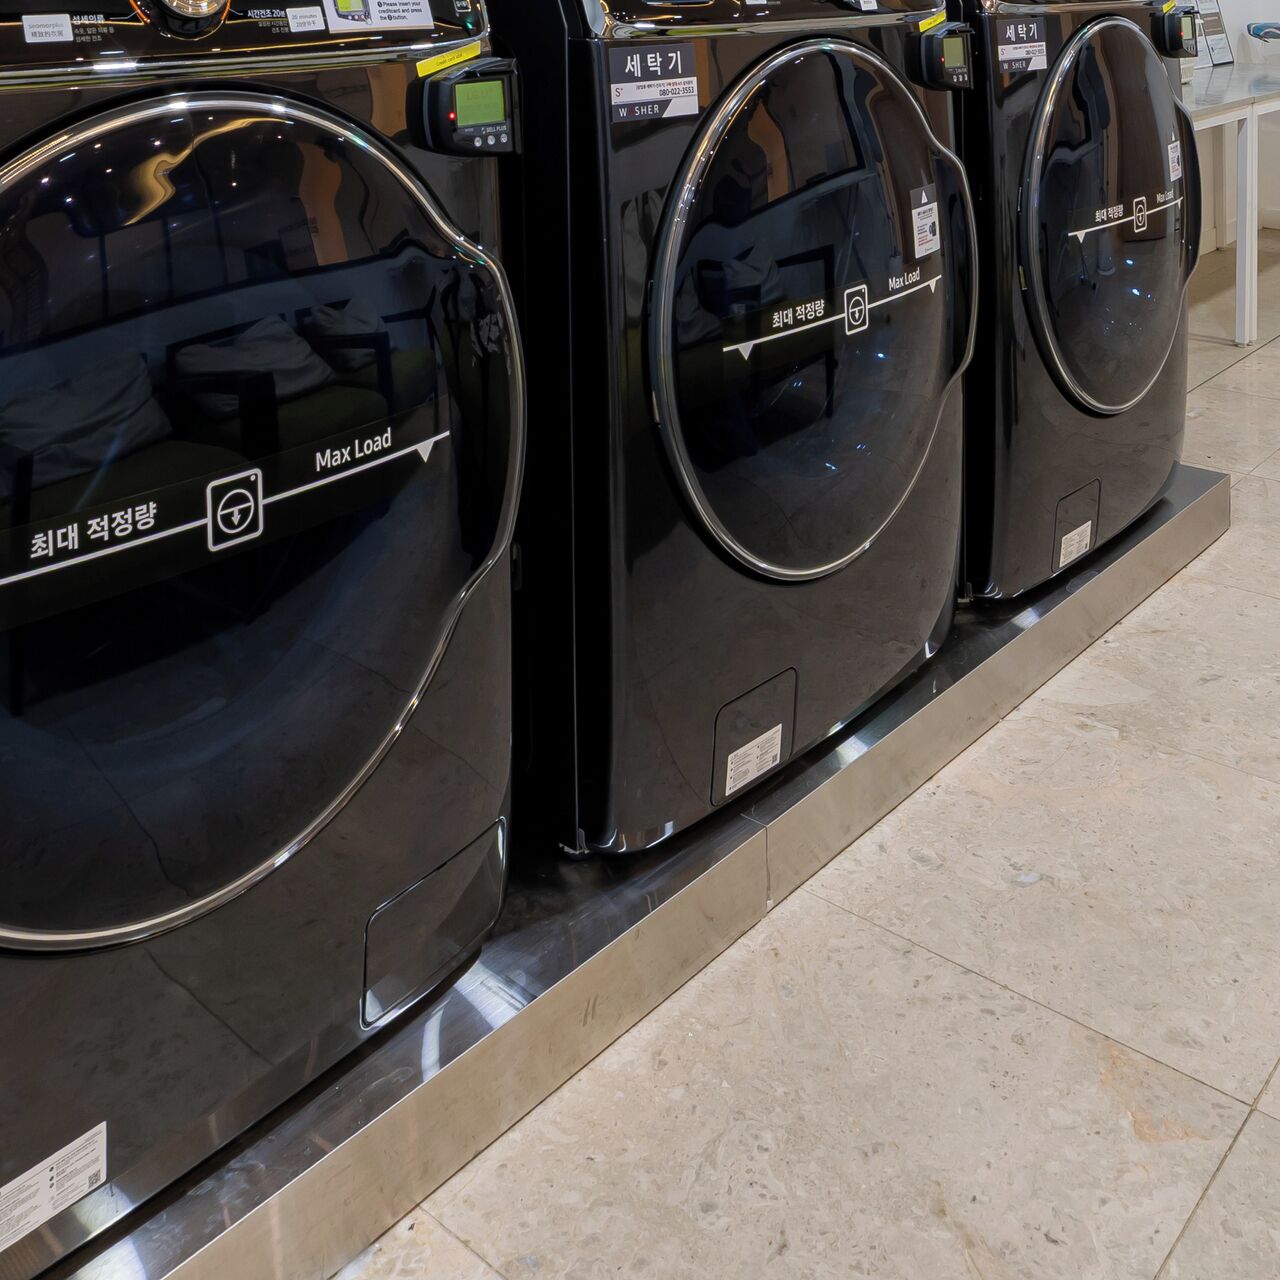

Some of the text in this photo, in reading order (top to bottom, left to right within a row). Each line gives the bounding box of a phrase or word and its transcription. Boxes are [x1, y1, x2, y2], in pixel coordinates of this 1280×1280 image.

[248, 9, 272, 19] 시간건조
[1006, 22, 1037, 41] 세탁기
[625, 51, 681, 77] 세탁기
[1003, 60, 1026, 70] WSHER
[659, 87, 694, 97] 080-022-3553
[1156, 188, 1174, 203] Max Load
[888, 267, 920, 291] Max Load
[772, 298, 825, 328] 최대 적정량
[315, 427, 392, 472] Max Load
[30, 501, 158, 559] 최대 적정량
